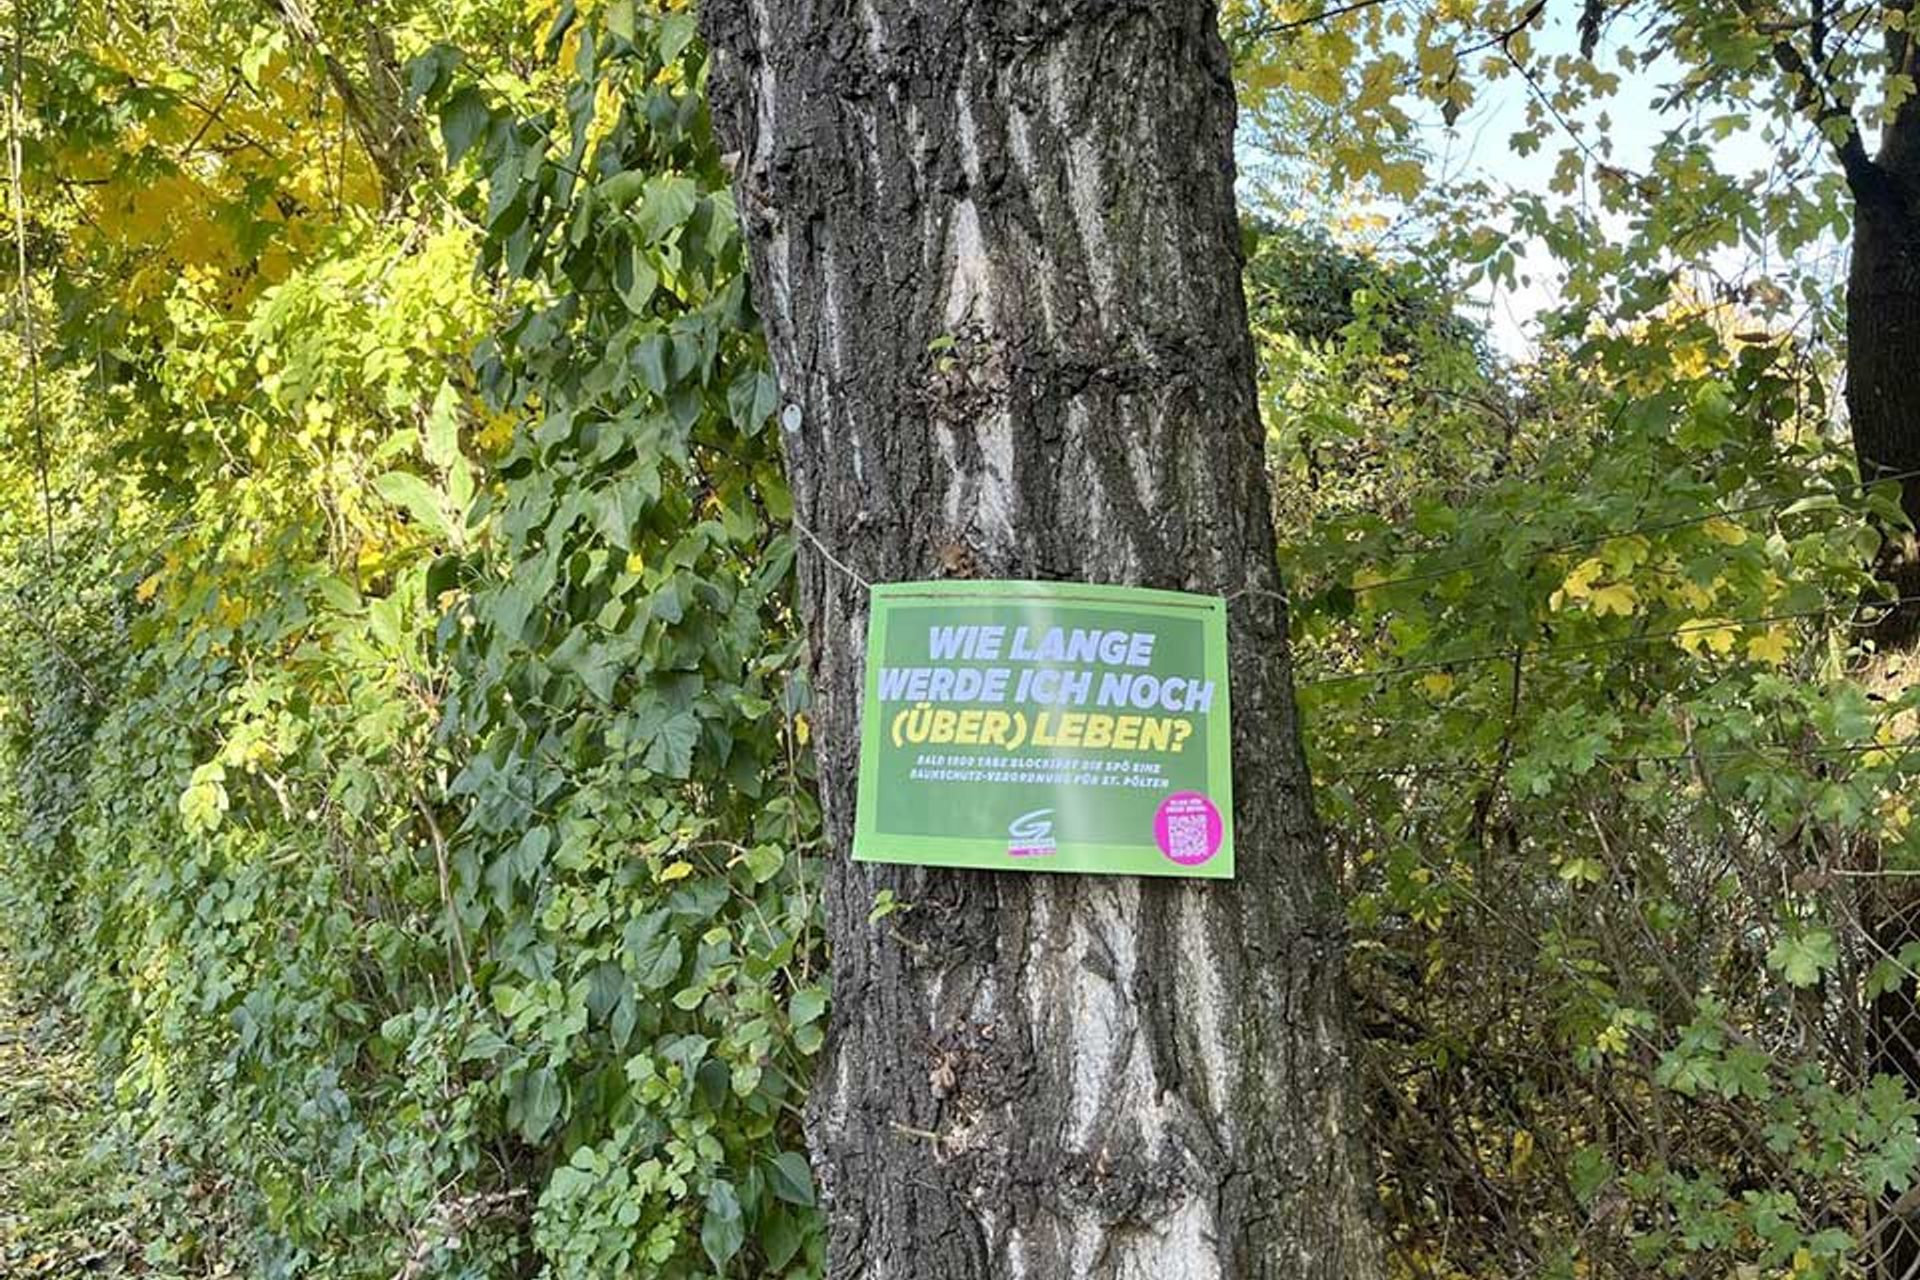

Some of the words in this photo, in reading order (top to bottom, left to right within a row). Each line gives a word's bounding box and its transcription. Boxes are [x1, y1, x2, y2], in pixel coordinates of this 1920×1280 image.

[929, 626, 1006, 660] WIE
[1008, 626, 1156, 667] LANGE
[878, 667, 1011, 702] WERDE
[1015, 668, 1092, 706] ICH
[1097, 672, 1215, 713] NOCH
[892, 702, 1027, 751] (ÜBER)
[1031, 711, 1192, 752] LEBEN?
[1073, 771, 1098, 785] FÜR
[1101, 775, 1120, 785] ST.
[1123, 773, 1170, 788] PÖLTEN
[1105, 758, 1131, 772] SPÖ
